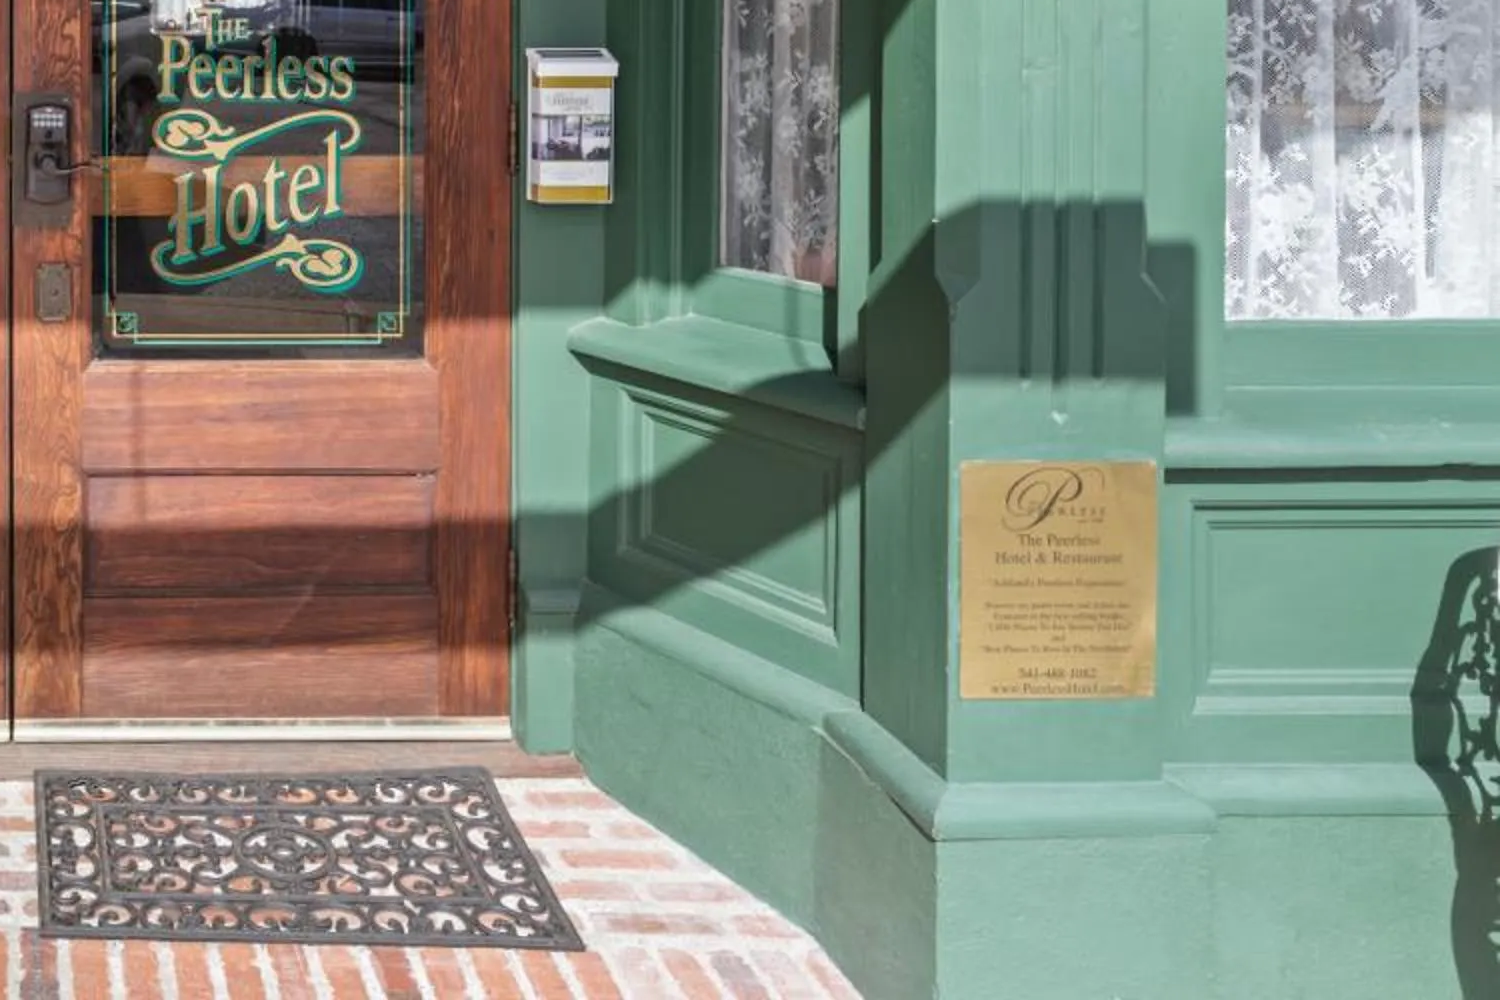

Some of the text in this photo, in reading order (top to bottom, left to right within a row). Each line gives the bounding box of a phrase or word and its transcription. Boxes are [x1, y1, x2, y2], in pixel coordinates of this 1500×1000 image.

[157, 32, 356, 102] Peerless
[168, 129, 343, 263] Hotel
[994, 552, 1031, 564] Hotel
[1018, 534, 1042, 546] The
